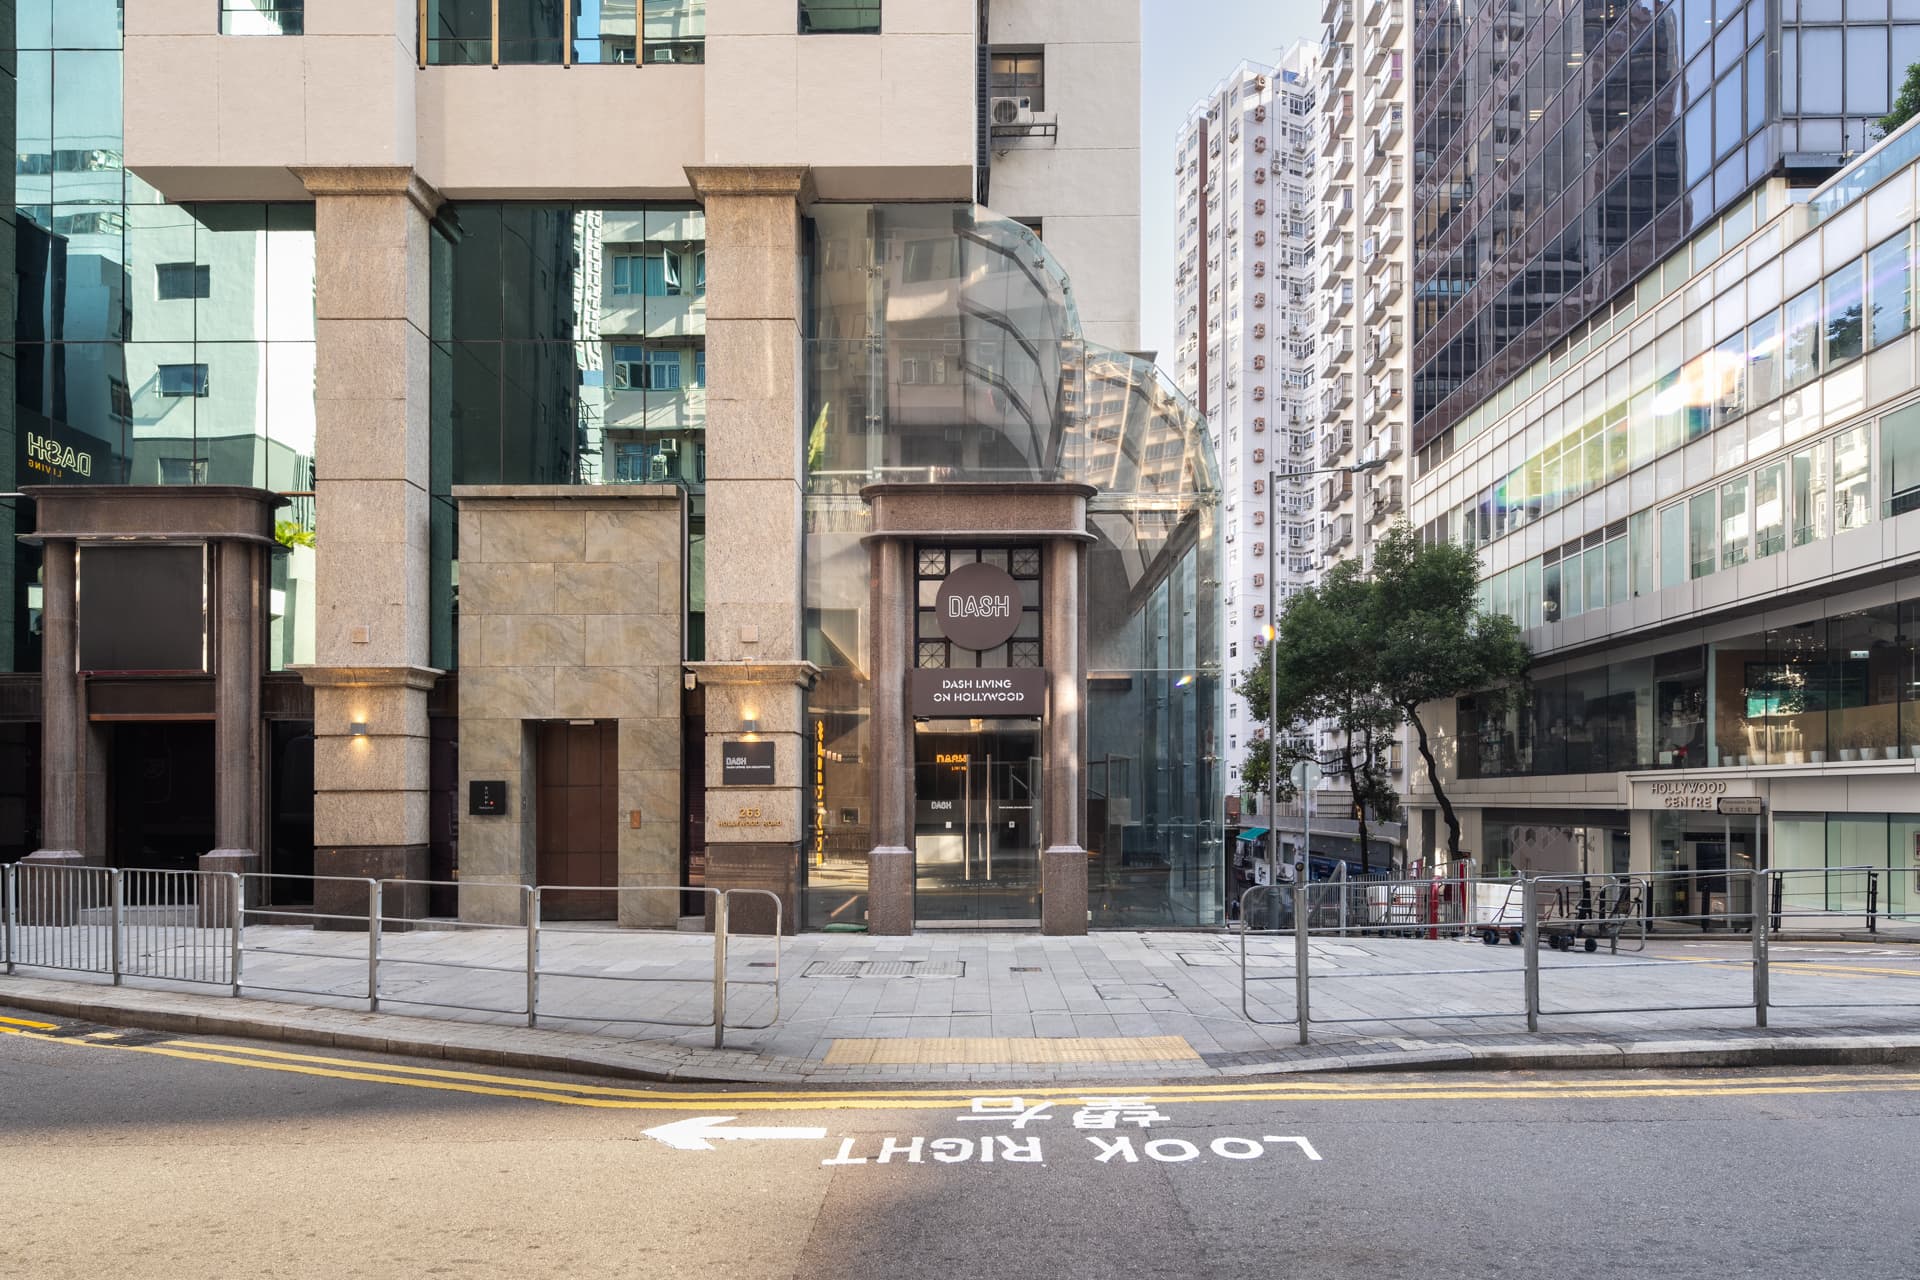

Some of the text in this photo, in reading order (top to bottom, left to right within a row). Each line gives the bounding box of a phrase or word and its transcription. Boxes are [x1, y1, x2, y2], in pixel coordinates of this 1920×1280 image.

[949, 595, 1009, 617] DASH
[942, 679, 1012, 689] DASH LIVING
[933, 692, 1025, 702] ON HOLLYWOOD
[726, 757, 747, 765] DASH
[1652, 782, 1727, 794] HOLLYWOOD
[931, 801, 952, 809] DASH
[1664, 796, 1712, 808] CENTRE
[740, 807, 761, 817] 263
[821, 1135, 1323, 1165] LOOK RIGHT
